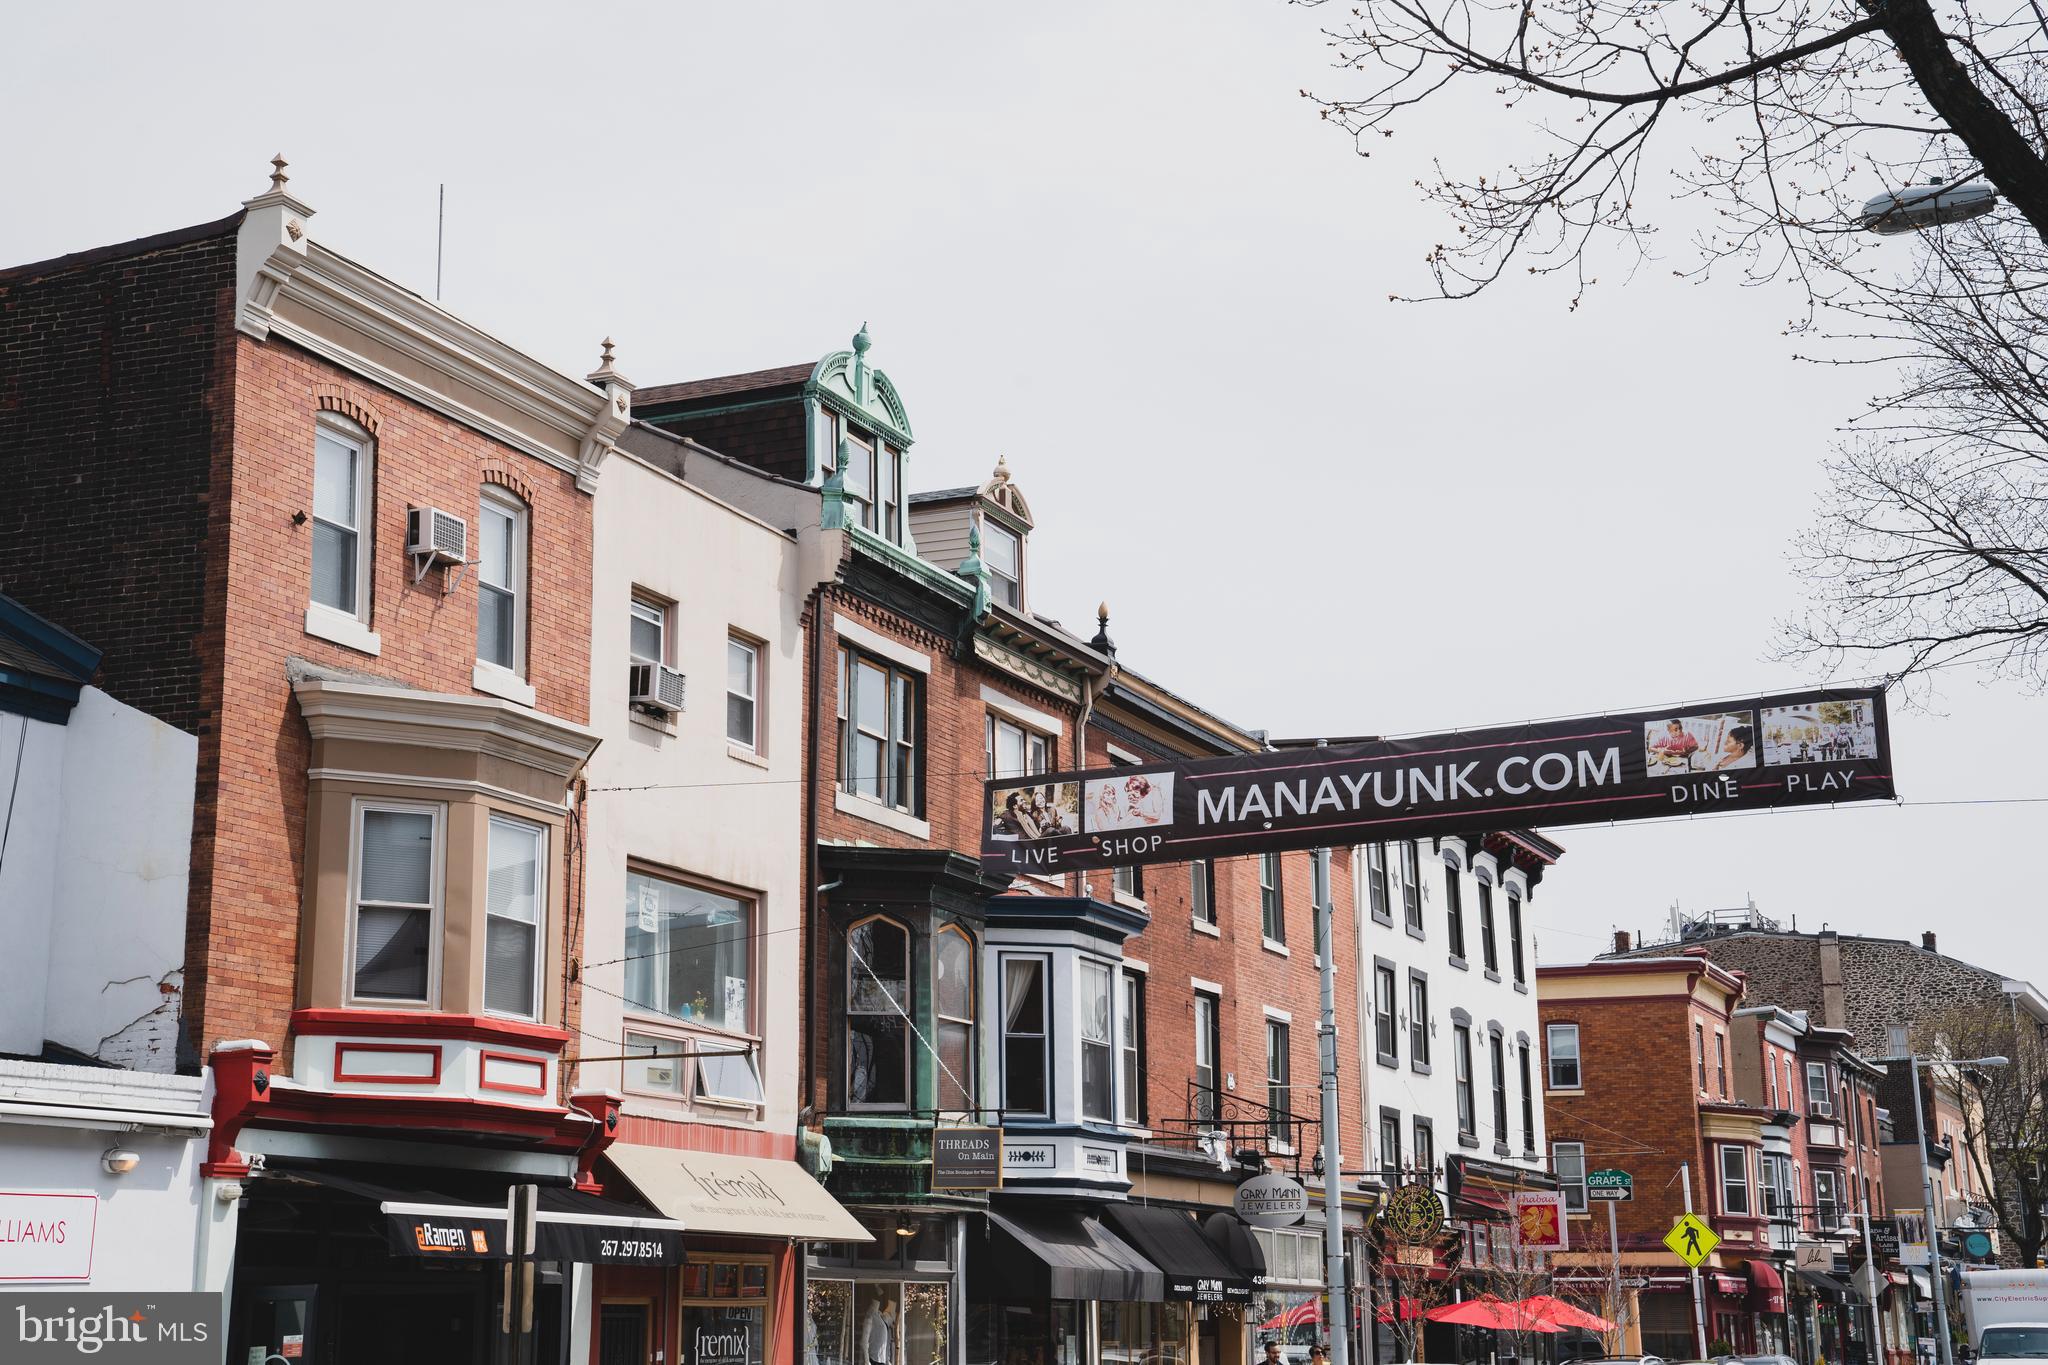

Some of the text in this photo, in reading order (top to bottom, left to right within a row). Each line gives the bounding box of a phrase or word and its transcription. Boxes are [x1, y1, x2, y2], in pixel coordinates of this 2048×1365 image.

[1197, 746, 1622, 825] MANAYUNK.COM
[1787, 770, 1855, 793] PLAY
[1671, 780, 1739, 803] DINE
[1102, 835, 1162, 857] SHOP
[1011, 846, 1059, 864] LIVE
[938, 1139, 990, 1150] THREADS
[957, 1152, 995, 1160] On Main
[1588, 1176, 1623, 1185] GRAPE
[1240, 1187, 1301, 1199] GARY MANN
[1241, 1201, 1301, 1210] JEWELERS
[600, 1239, 663, 1258] 267.297.8514
[1197, 1293, 1223, 1301] JEWELERS
[728, 1307, 751, 1319] OPEN
